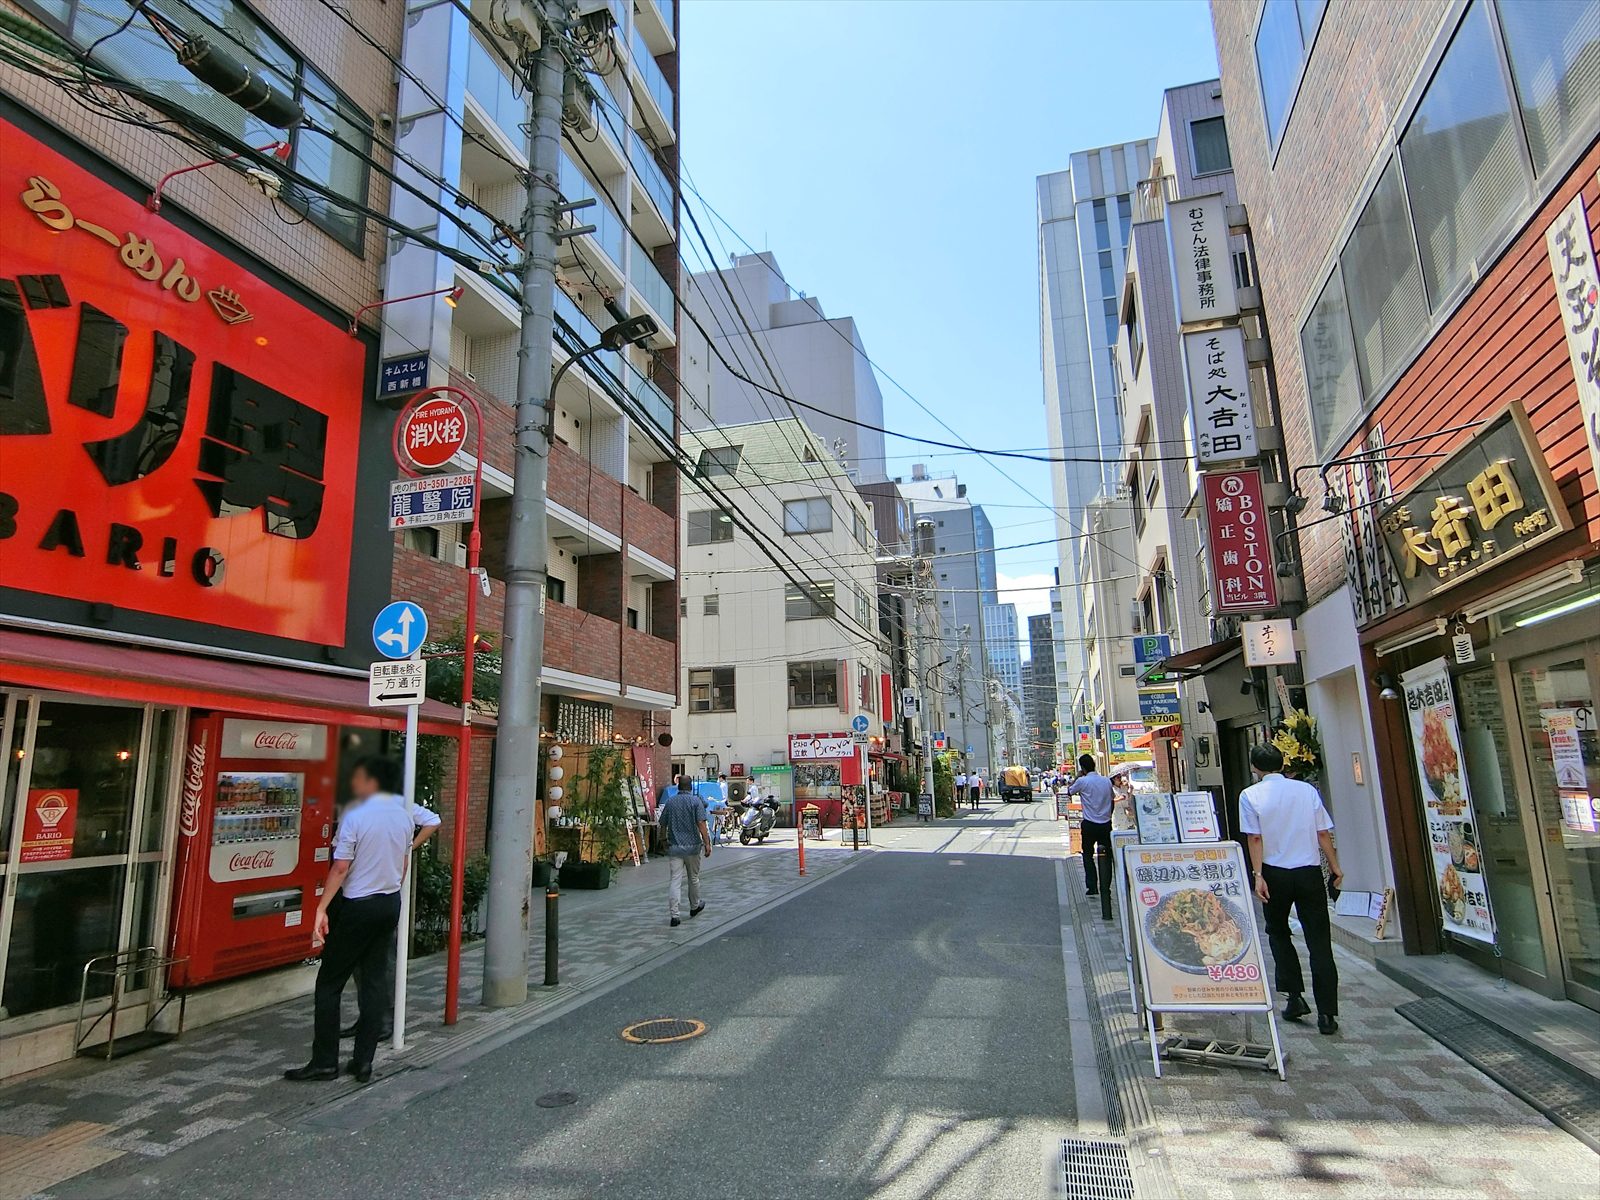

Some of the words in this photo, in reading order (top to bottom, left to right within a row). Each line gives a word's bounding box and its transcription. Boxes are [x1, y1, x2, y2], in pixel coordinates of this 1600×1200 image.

[20, 175, 202, 302] らーめん
[1188, 207, 1216, 310] むさん法律事務所
[1205, 336, 1227, 380] そば処
[385, 359, 426, 377] キムスビル
[387, 377, 422, 392] 西新橋
[415, 410, 429, 419] FIRE
[429, 406, 456, 417] HYDRANT
[1204, 385, 1242, 454] 大吉田
[1239, 391, 1252, 441] おおよしだ
[410, 416, 462, 449] 消火栓
[394, 480, 418, 494] 虎の門
[418, 475, 472, 490] 03-3501-2286
[393, 487, 472, 517] 龍醫院
[408, 510, 465, 524] 手前二つ目角左折
[1400, 457, 1526, 580] 大吉田
[1215, 497, 1243, 593] 矯正歯科
[1238, 495, 1264, 591] BOSTON
[1226, 593, 1248, 601] 当ビル
[1253, 591, 1267, 599] 3階
[1143, 637, 1158, 656] P
[1261, 624, 1275, 657] 芋つる
[373, 663, 422, 677] 自転車を除く
[373, 677, 422, 690] 一方通行
[1153, 697, 1178, 705] PARKING
[254, 730, 300, 750] Coca-Cola
[1110, 731, 1122, 745] P
[794, 749, 808, 757] 立飲
[179, 743, 207, 837] Coca-Cola
[36, 832, 63, 840] BARIO
[229, 849, 276, 872] Coca-Cola
[1136, 862, 1236, 883] 磯辺かき揚げ
[1210, 881, 1242, 897] そば
[1207, 964, 1260, 982] ¥480
